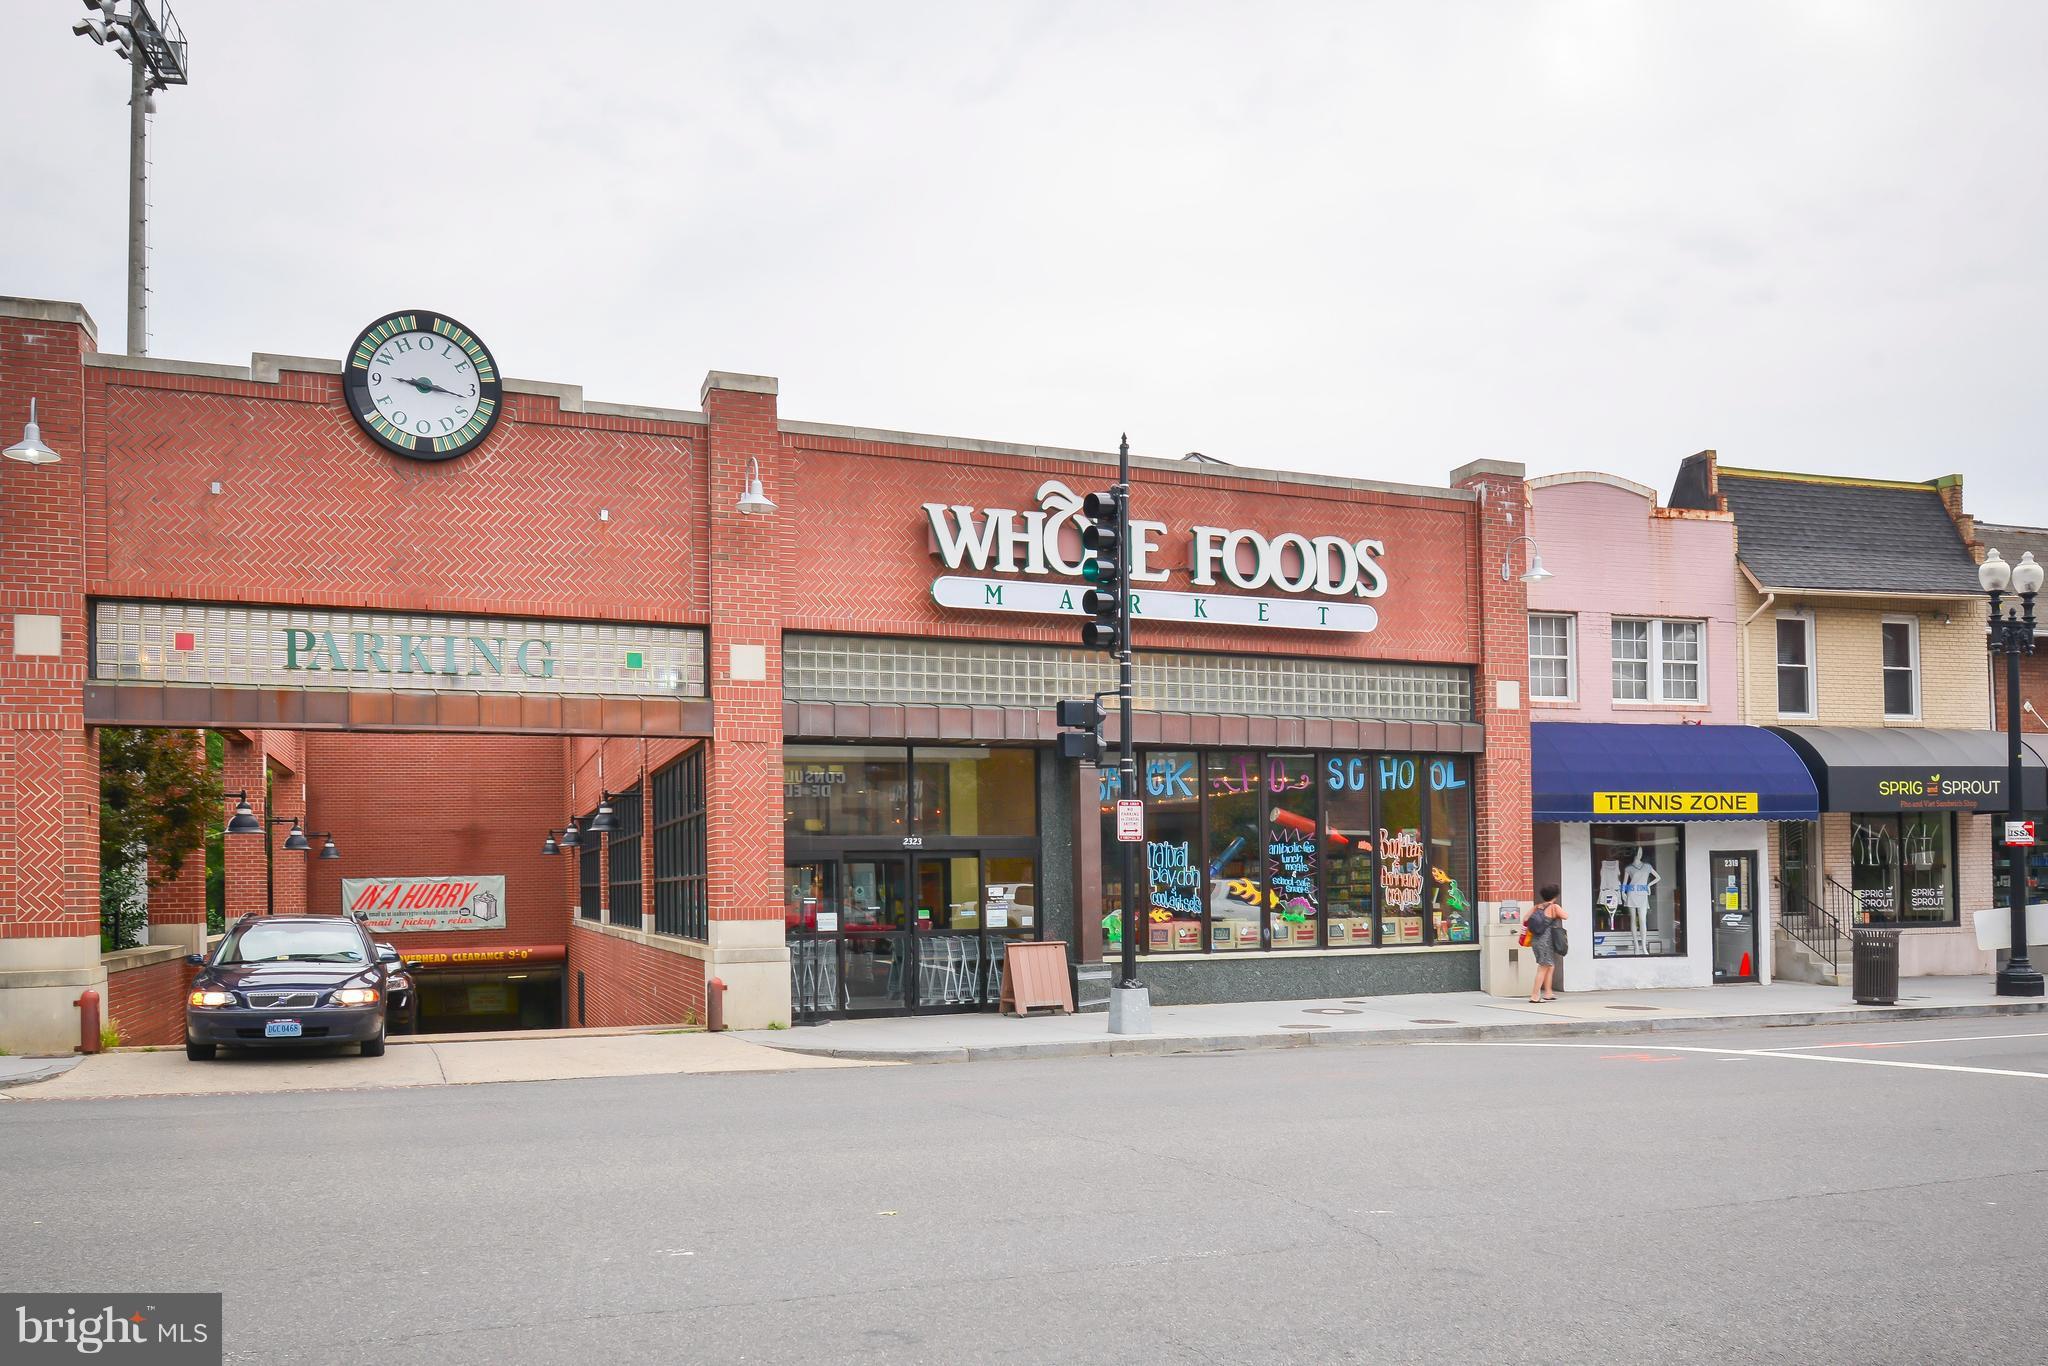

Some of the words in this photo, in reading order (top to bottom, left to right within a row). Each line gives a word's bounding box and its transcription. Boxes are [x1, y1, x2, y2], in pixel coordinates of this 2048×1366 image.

[376, 336, 470, 374] WHOLE
[372, 373, 382, 386] 9
[467, 383, 476, 397] 3
[377, 395, 469, 434] FOODS
[922, 481, 1170, 583] WHOE
[1190, 526, 1388, 599] FOODS
[984, 584, 1331, 626] MARKET
[282, 628, 556, 678] PARKING
[1327, 757, 1467, 792] SCHOOL
[1879, 780, 1923, 796] SPRIG
[1942, 780, 2000, 795] SPROUT
[1605, 795, 1683, 810] TENNIS
[1690, 795, 1747, 811] ZONE
[903, 837, 922, 845] 2323
[1147, 842, 1188, 868] natural
[1724, 859, 1739, 867] 2319
[351, 884, 386, 910] IN
[378, 884, 402, 909] A
[398, 881, 480, 909] HURRY
[1860, 889, 1884, 898] SPRIG
[1911, 888, 1935, 897] SPRIG
[1911, 897, 1945, 907] SPROUT
[402, 916, 438, 929] pickup
[447, 916, 475, 925] relax
[451, 951, 505, 962] CLEARANCE
